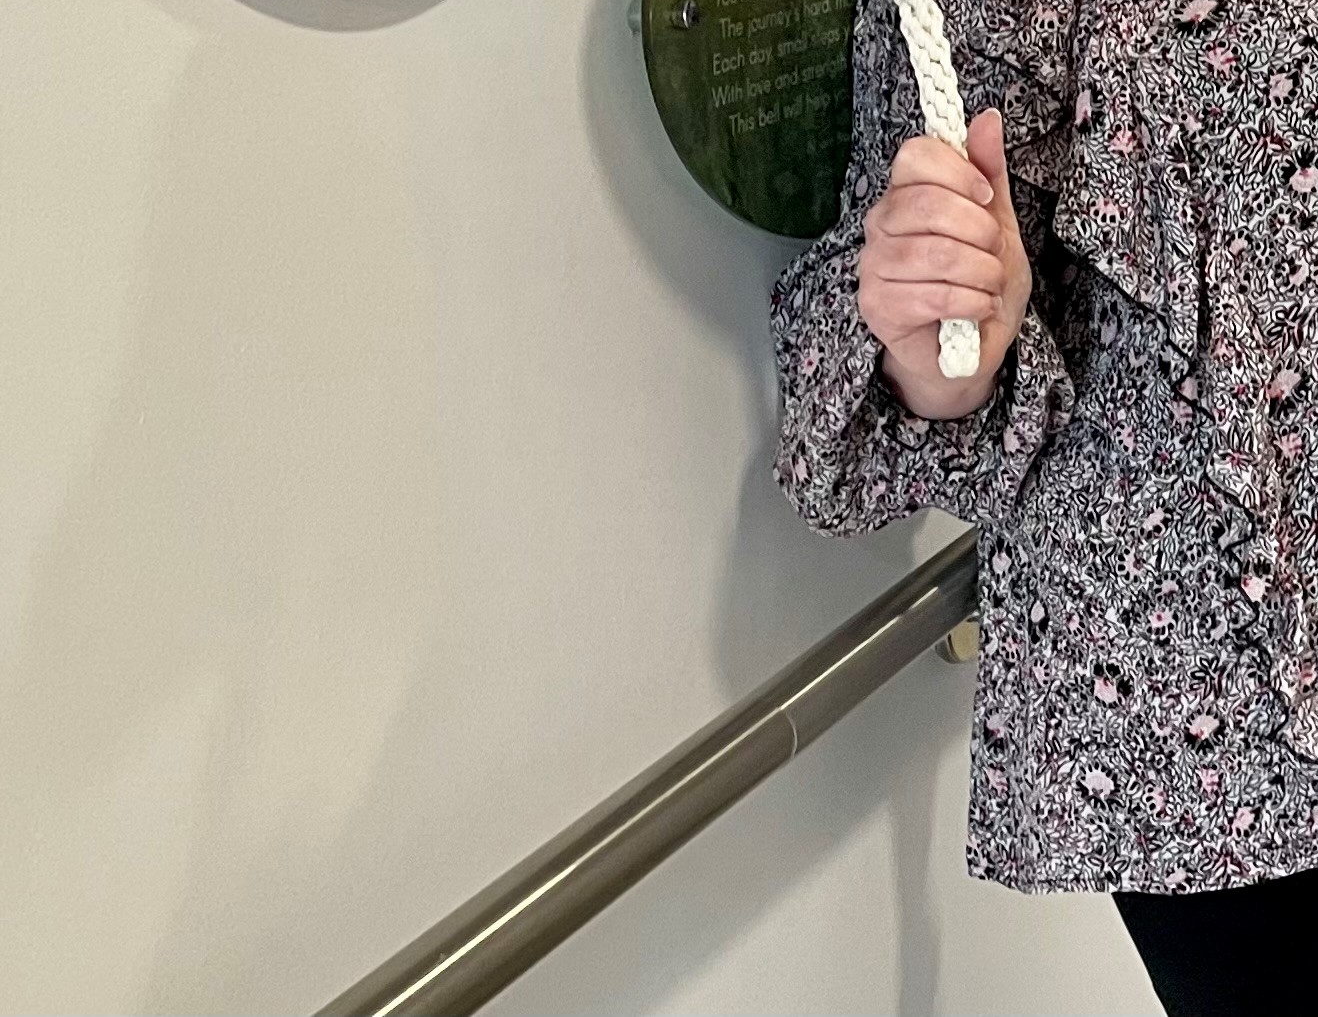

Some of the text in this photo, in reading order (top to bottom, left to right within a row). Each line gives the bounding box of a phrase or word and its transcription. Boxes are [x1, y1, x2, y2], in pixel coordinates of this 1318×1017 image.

[719, 16, 744, 38] The
[713, 47, 745, 75] Each
[712, 81, 743, 108] With
[746, 78, 771, 98] love
[774, 65, 800, 89] and
[729, 112, 755, 136] This
[758, 102, 780, 127] bell
